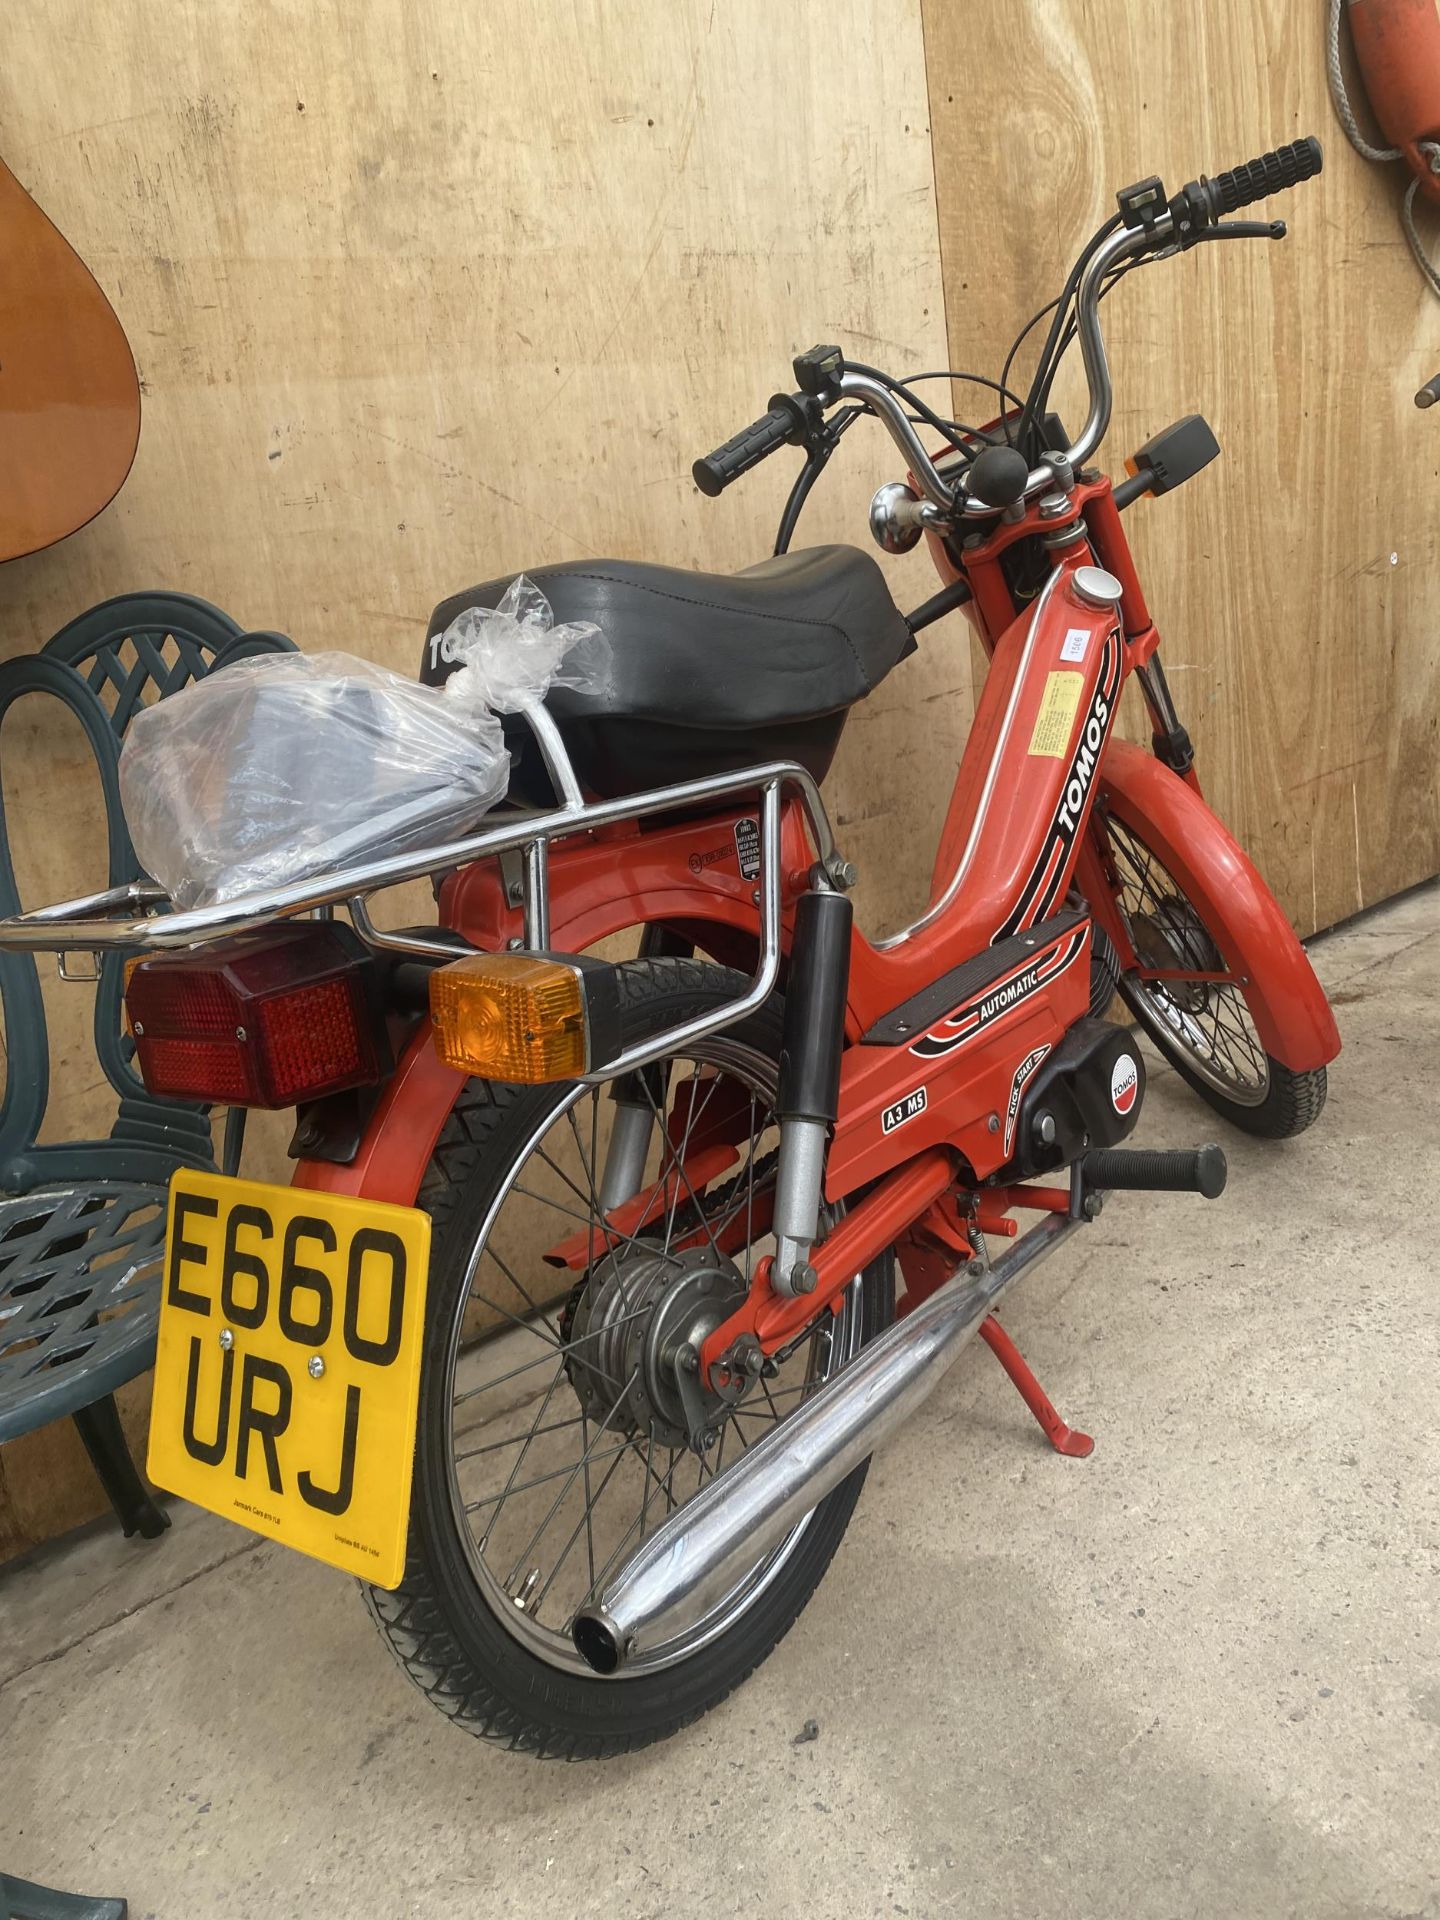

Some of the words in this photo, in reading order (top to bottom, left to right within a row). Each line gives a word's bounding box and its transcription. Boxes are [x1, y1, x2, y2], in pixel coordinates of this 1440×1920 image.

[1058, 694, 1108, 833] TOMOS
[980, 971, 1037, 1021] AUTOMATIC
[907, 1092, 924, 1115] MS
[1009, 1087, 1019, 1114] KICK
[1016, 1058, 1033, 1083] START
[1113, 1071, 1136, 1098] TOMOS
[168, 1191, 407, 1367] E660
[183, 1336, 361, 1516] URJ
